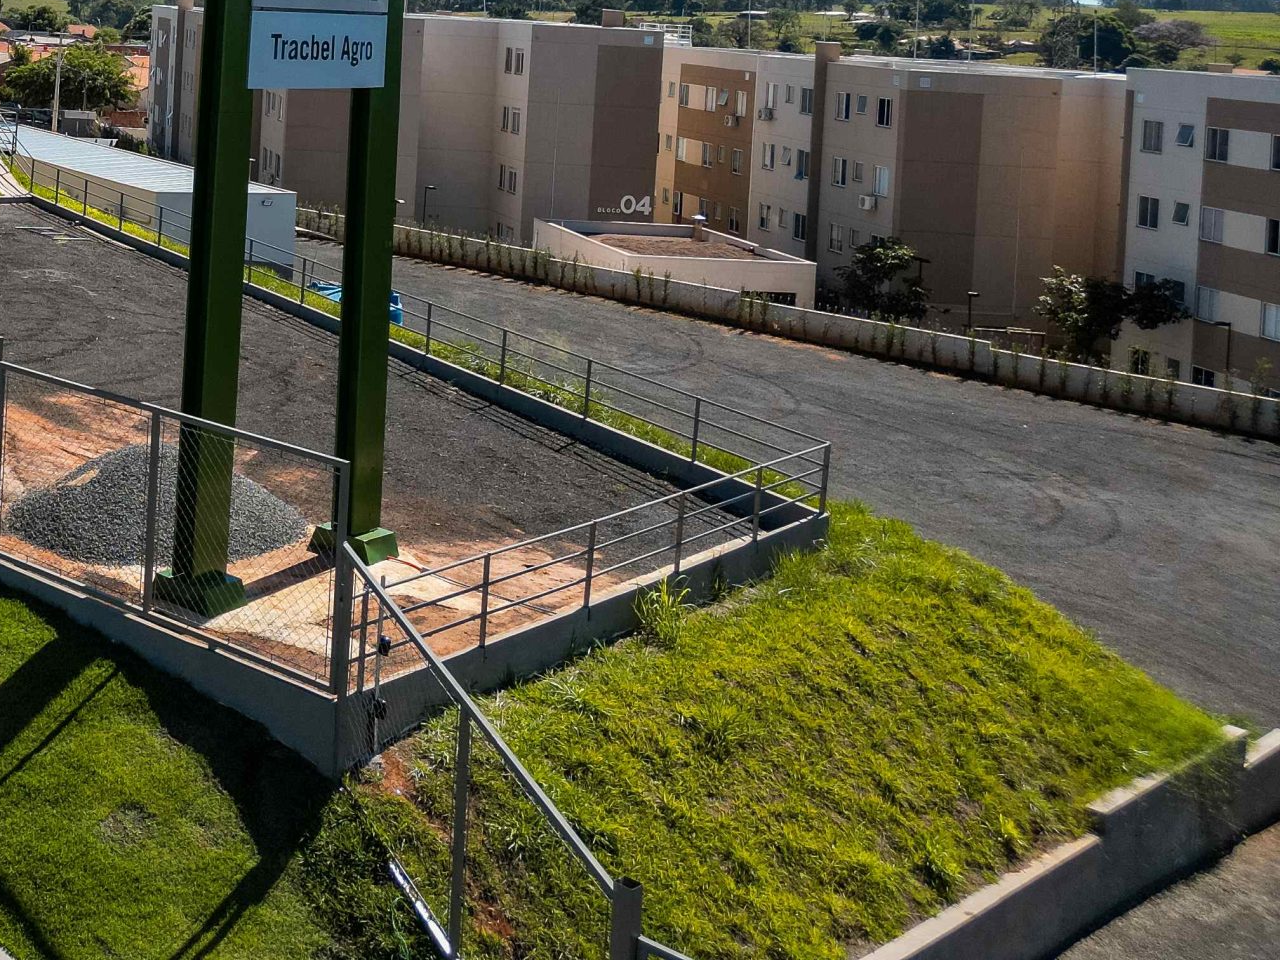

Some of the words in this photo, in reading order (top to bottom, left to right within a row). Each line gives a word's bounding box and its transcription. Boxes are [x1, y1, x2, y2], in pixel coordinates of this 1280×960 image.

[271, 33, 335, 61] Tracbel
[341, 35, 373, 67] Agro
[620, 194, 652, 216] 04
